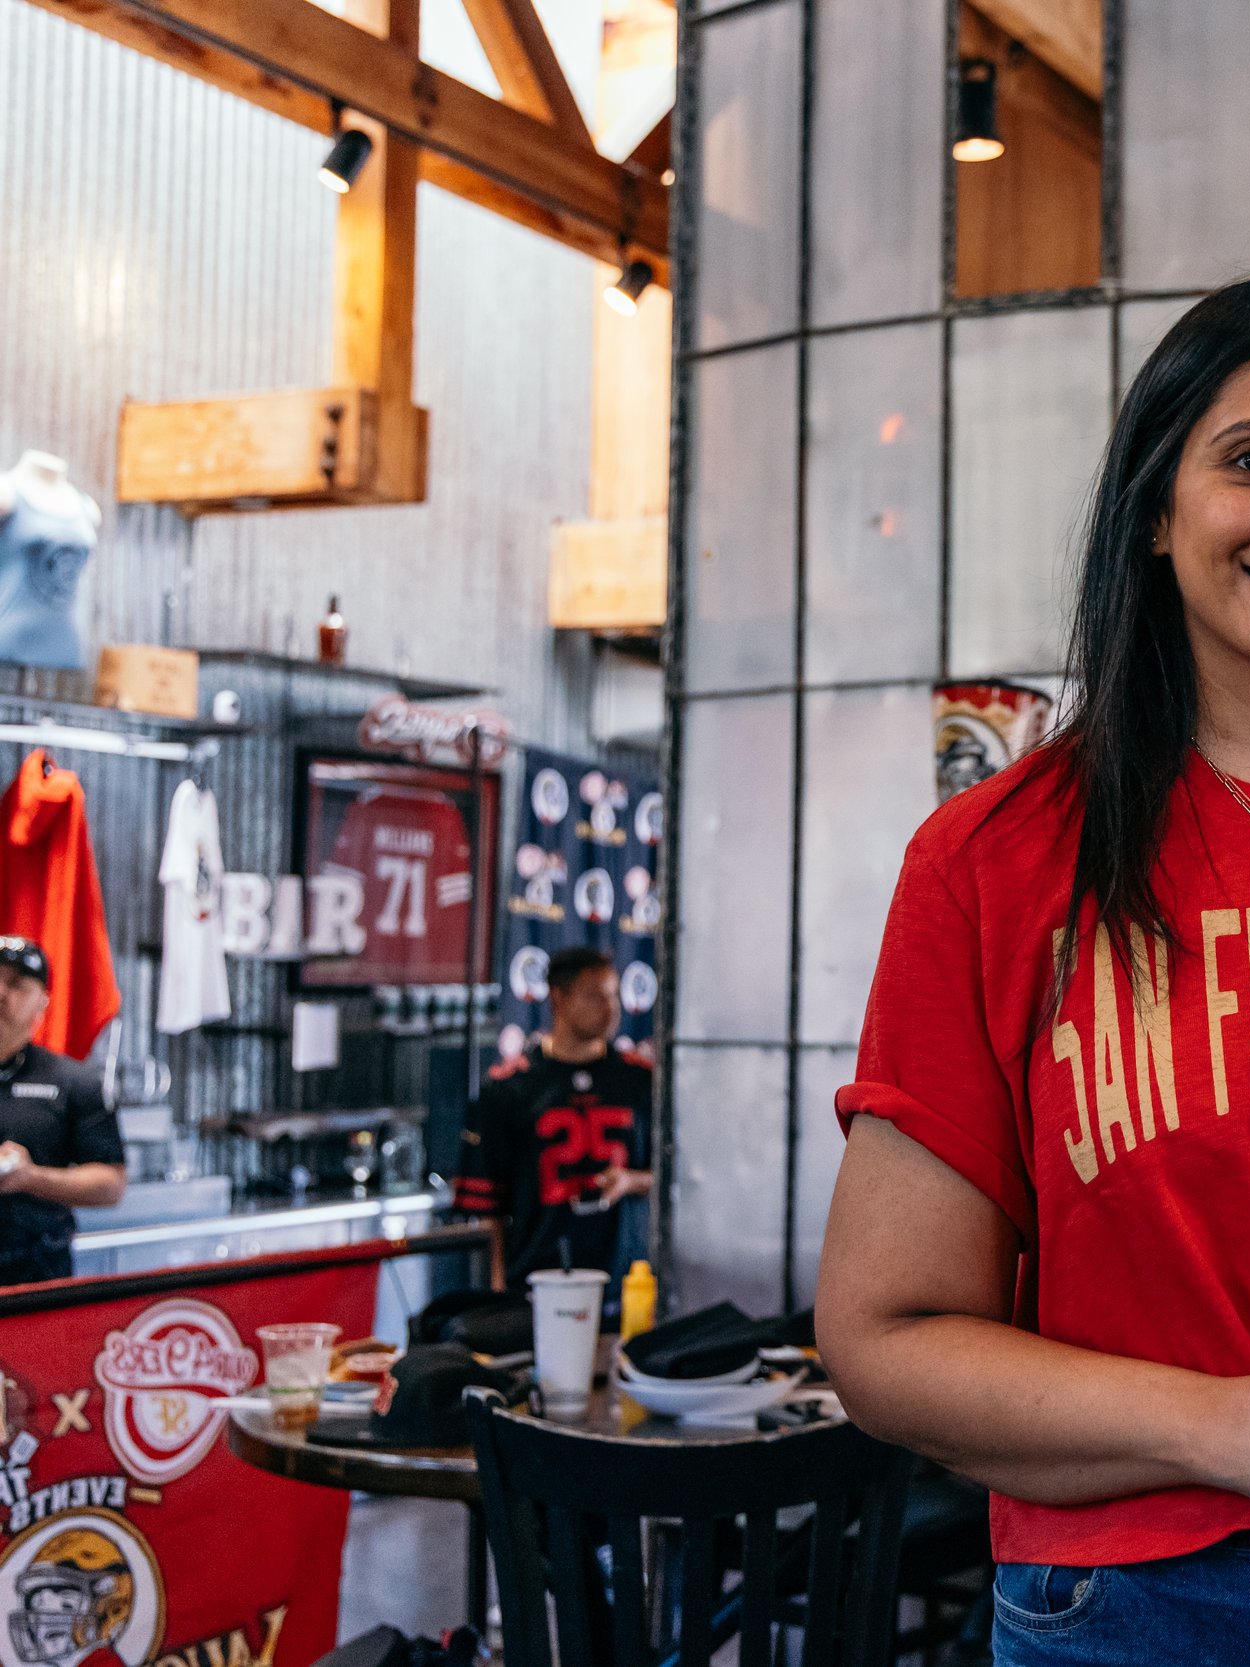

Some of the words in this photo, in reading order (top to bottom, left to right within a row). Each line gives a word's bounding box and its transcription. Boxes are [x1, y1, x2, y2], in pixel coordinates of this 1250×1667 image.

[374, 854, 428, 939] 71
[1052, 917, 1181, 1185] SAN
[535, 1106, 635, 1206] 25
